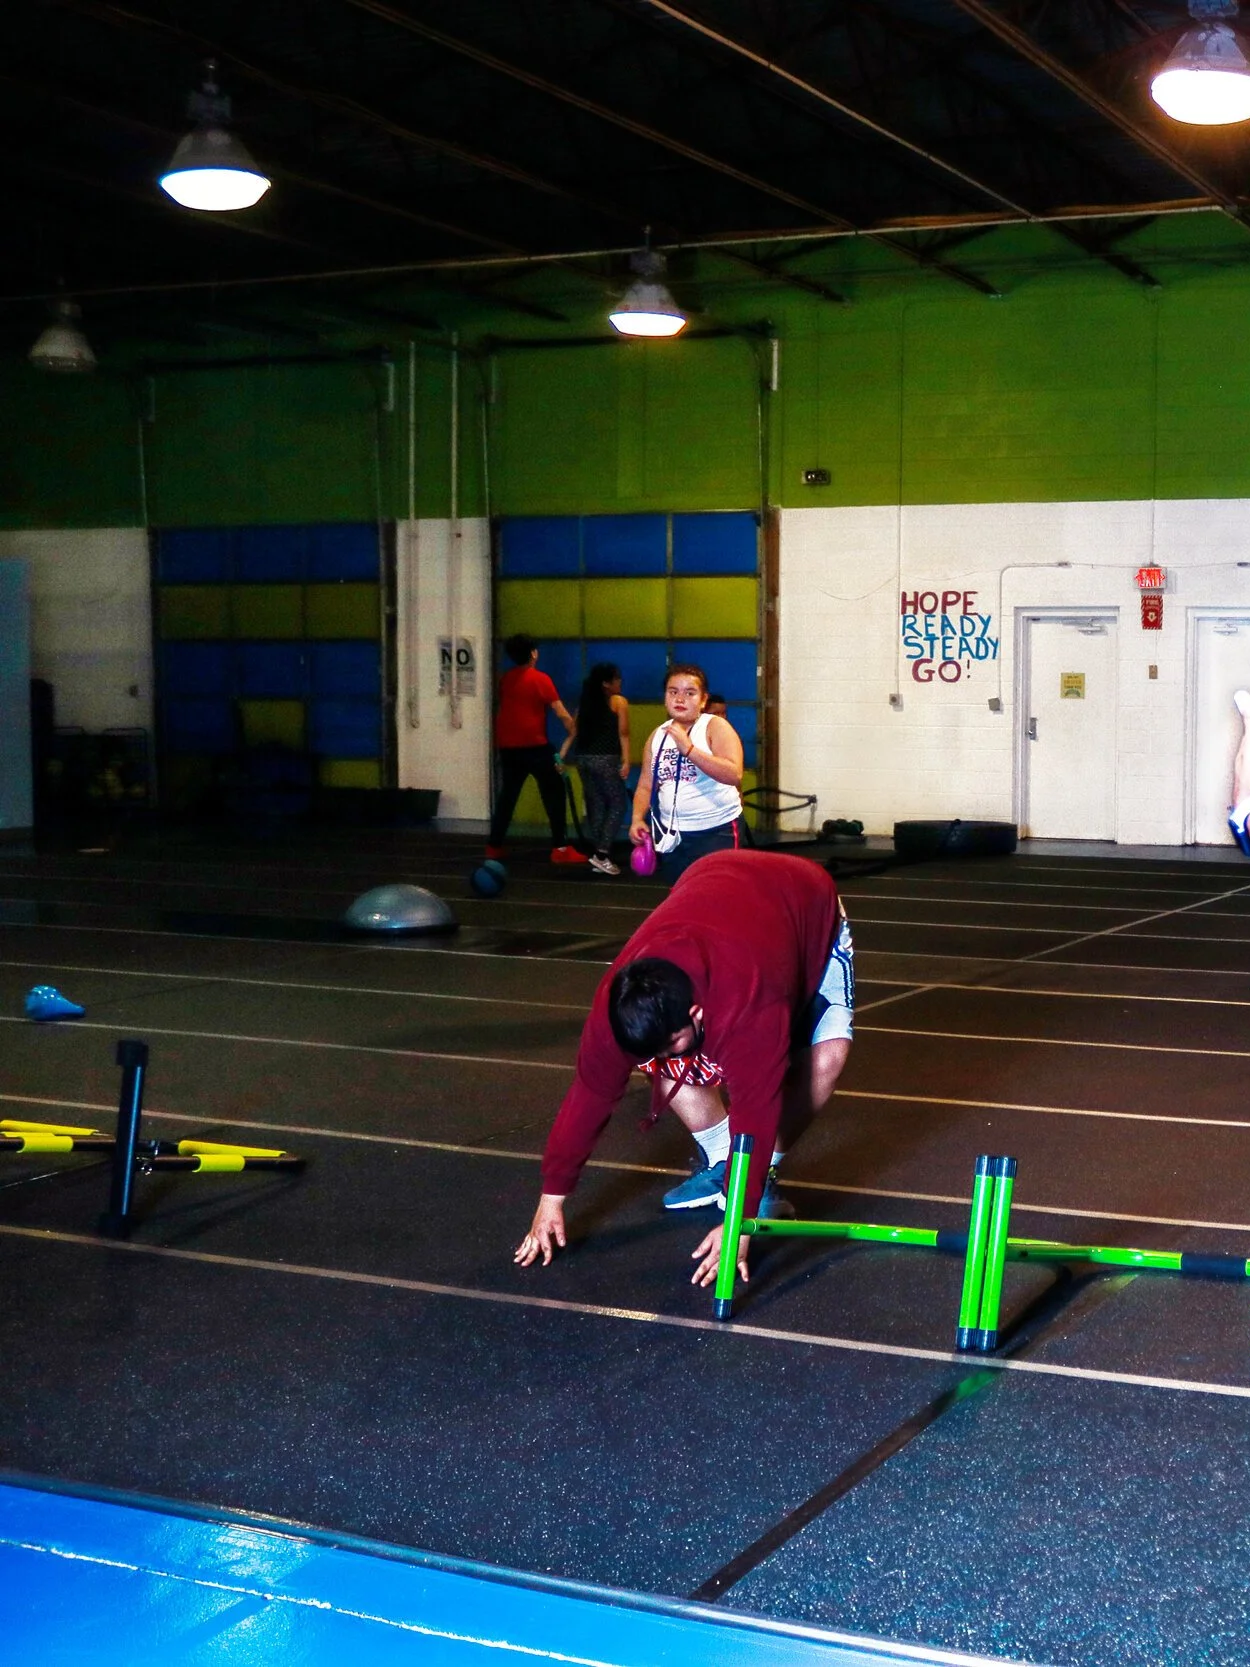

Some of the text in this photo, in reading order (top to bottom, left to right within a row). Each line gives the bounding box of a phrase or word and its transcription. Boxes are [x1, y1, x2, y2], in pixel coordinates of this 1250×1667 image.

[901, 590, 978, 615] HOPE
[902, 614, 991, 637] READY
[441, 648, 470, 666] NO
[903, 636, 999, 660] STEADY
[912, 658, 971, 683] GO!
